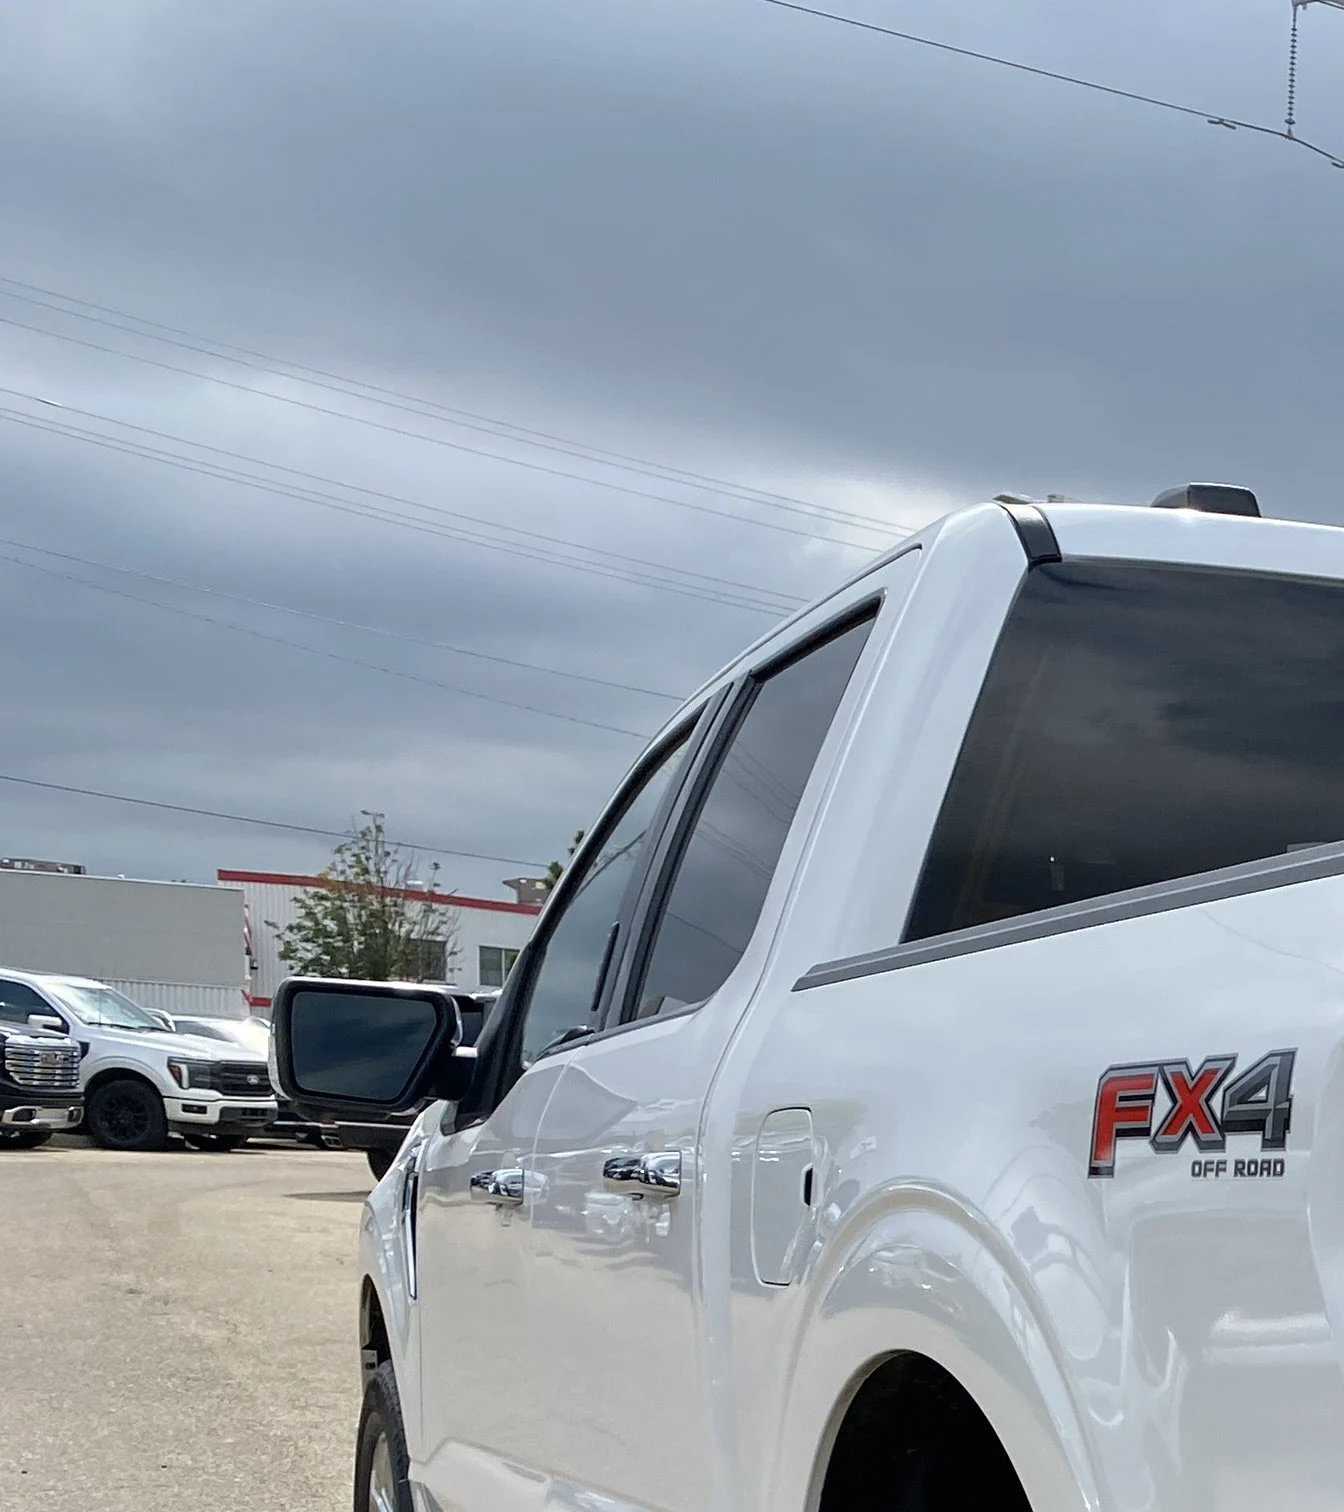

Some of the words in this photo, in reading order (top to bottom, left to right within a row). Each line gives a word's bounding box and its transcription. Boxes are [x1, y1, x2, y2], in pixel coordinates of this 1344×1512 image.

[1087, 1047, 1298, 1178] FX4
[1191, 1158, 1227, 1178] OFF
[1233, 1158, 1286, 1178] ROAD
